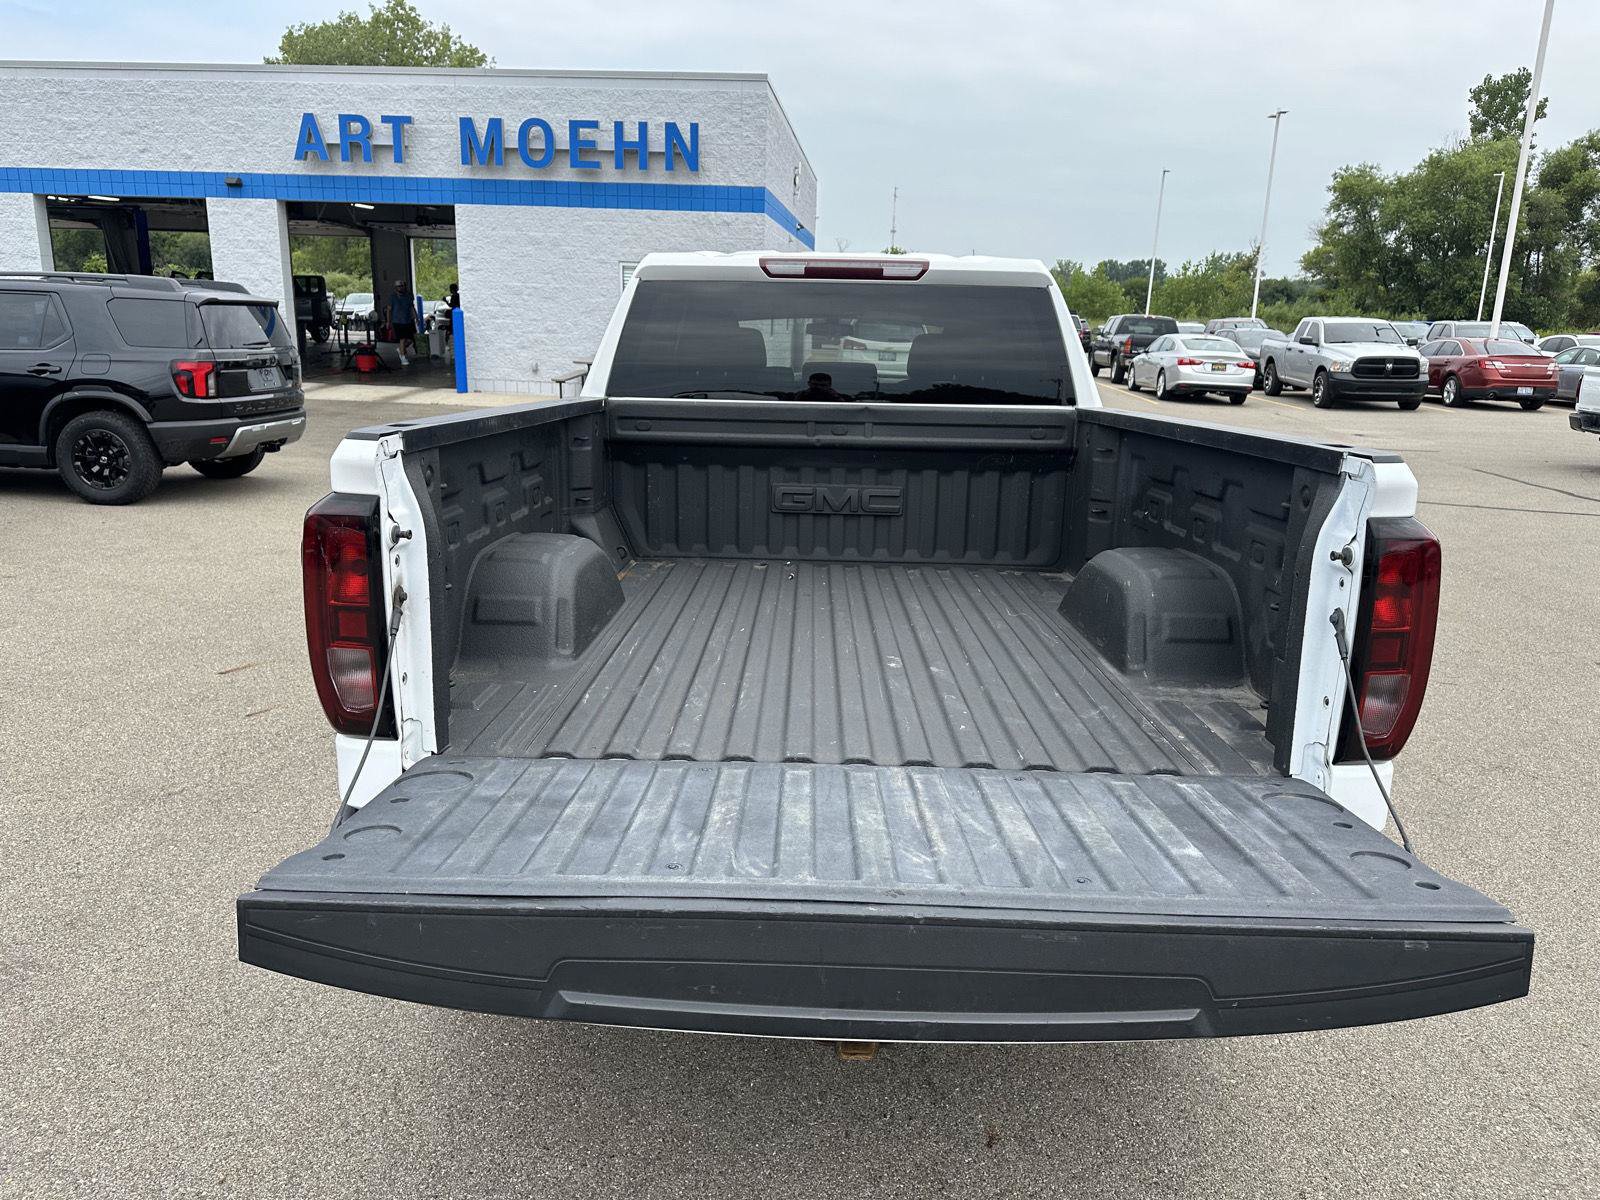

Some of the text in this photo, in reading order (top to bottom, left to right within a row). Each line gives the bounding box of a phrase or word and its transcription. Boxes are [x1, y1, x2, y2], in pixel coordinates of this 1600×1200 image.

[294, 112, 699, 172] ART MOEHN
[774, 486, 902, 513] GMC
